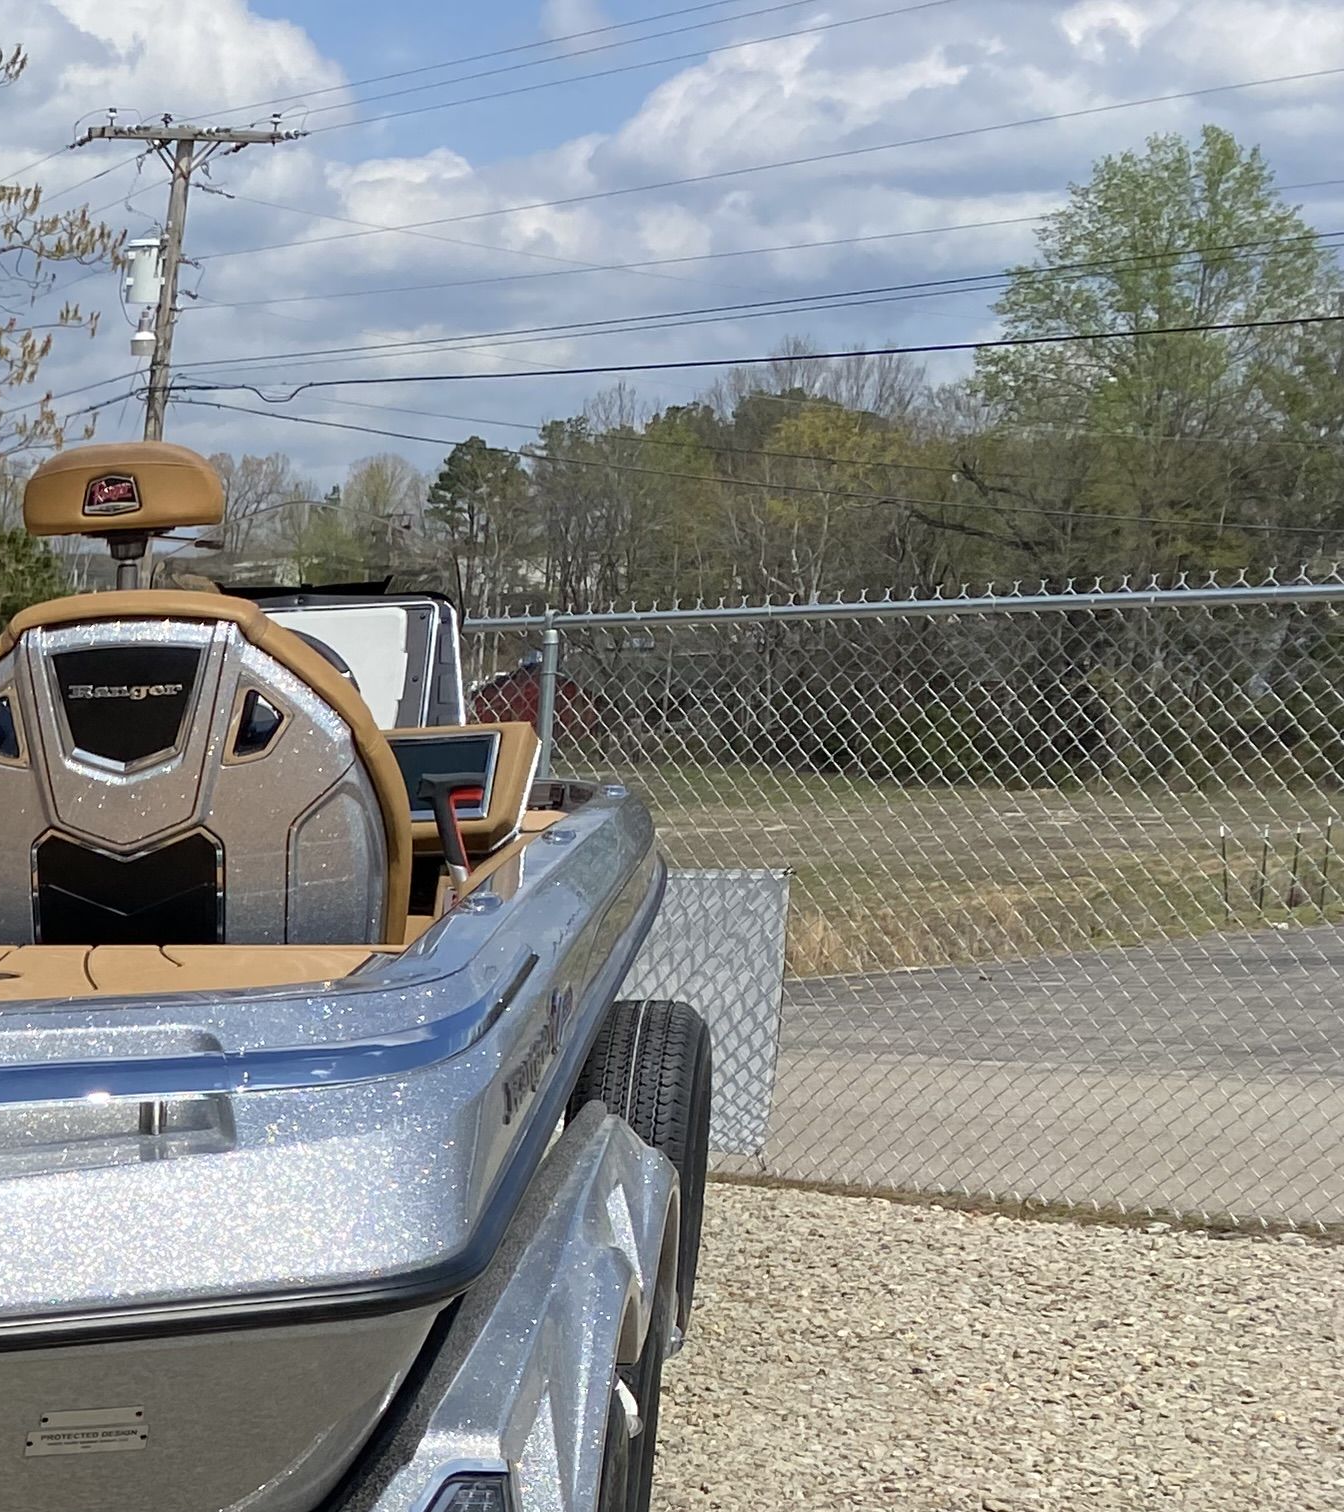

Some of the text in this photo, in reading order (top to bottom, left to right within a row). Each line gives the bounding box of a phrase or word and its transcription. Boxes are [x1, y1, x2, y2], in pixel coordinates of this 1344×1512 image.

[68, 684, 182, 700] Ranger
[40, 1429, 138, 1441] PROTECTED DESIGN
